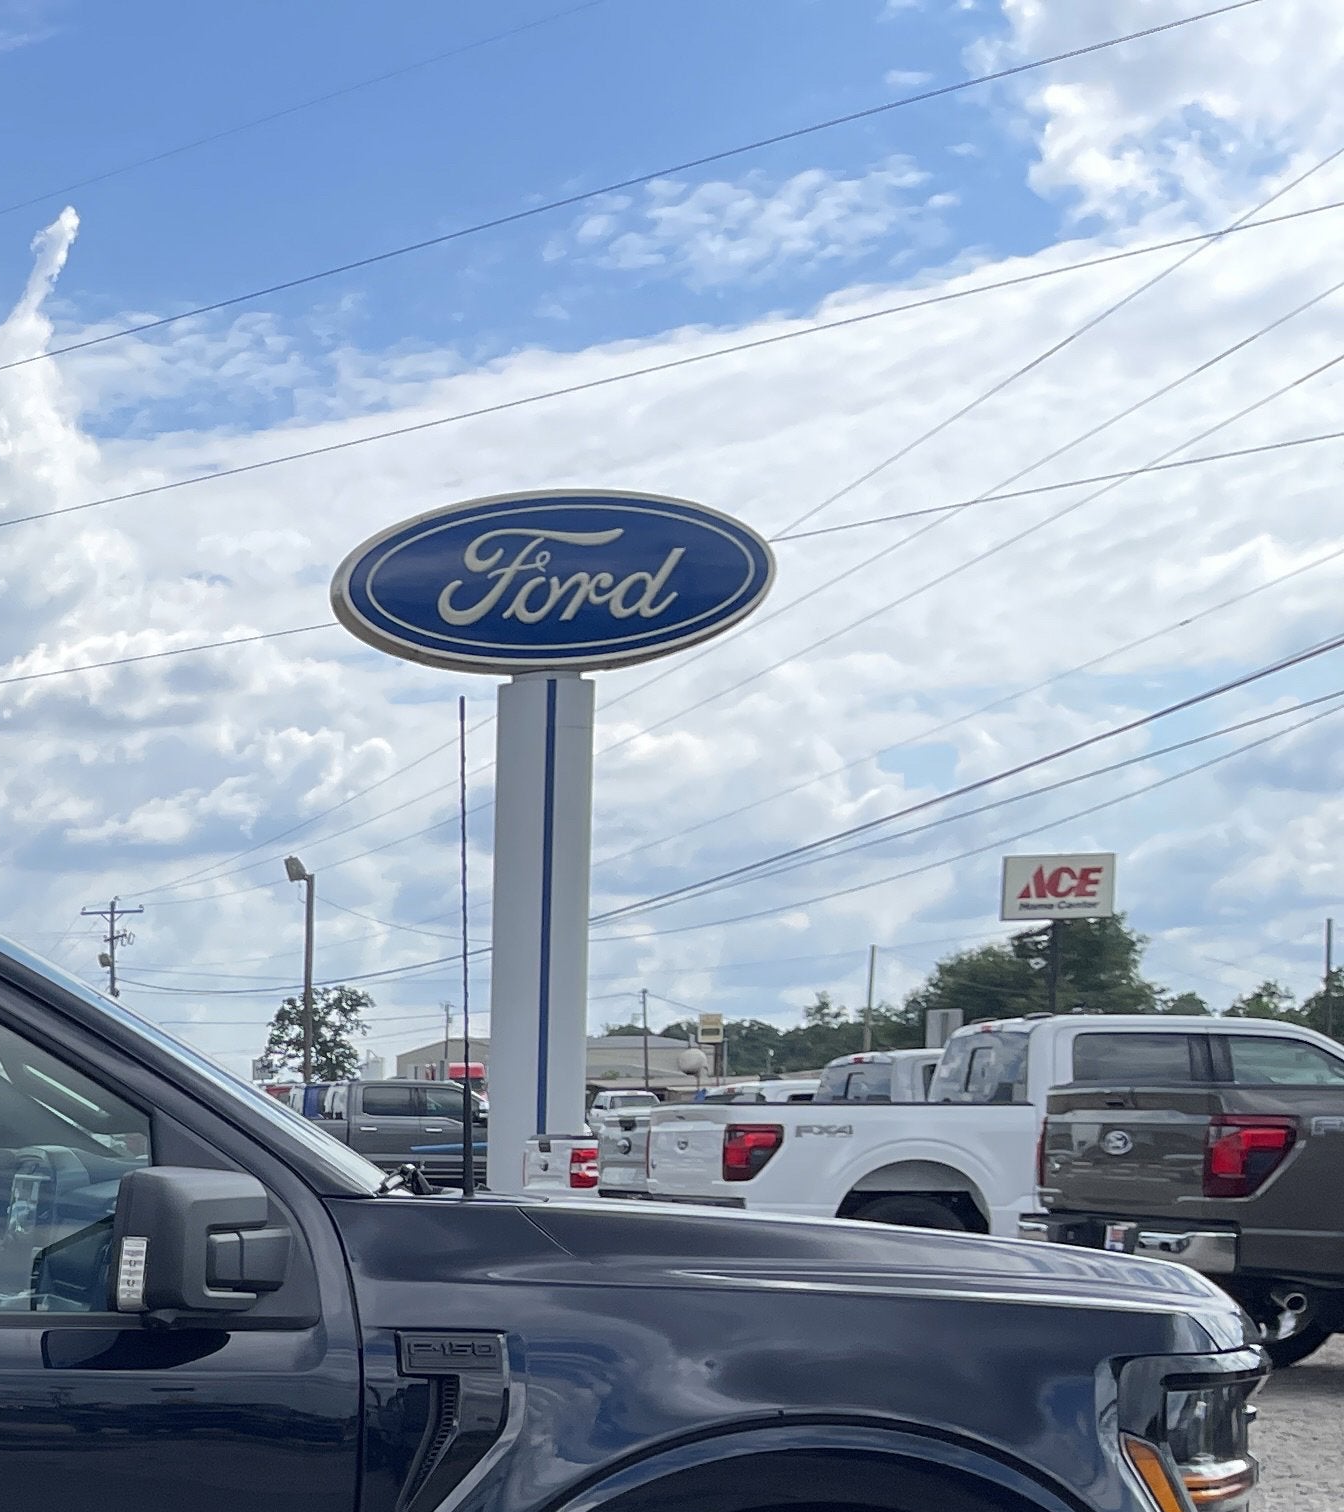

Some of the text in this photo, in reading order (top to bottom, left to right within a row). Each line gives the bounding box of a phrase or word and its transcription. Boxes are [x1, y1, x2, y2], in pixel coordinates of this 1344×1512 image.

[437, 527, 686, 626] Ford
[1017, 864, 1104, 899] ACE
[794, 1124, 854, 1138] FX4
